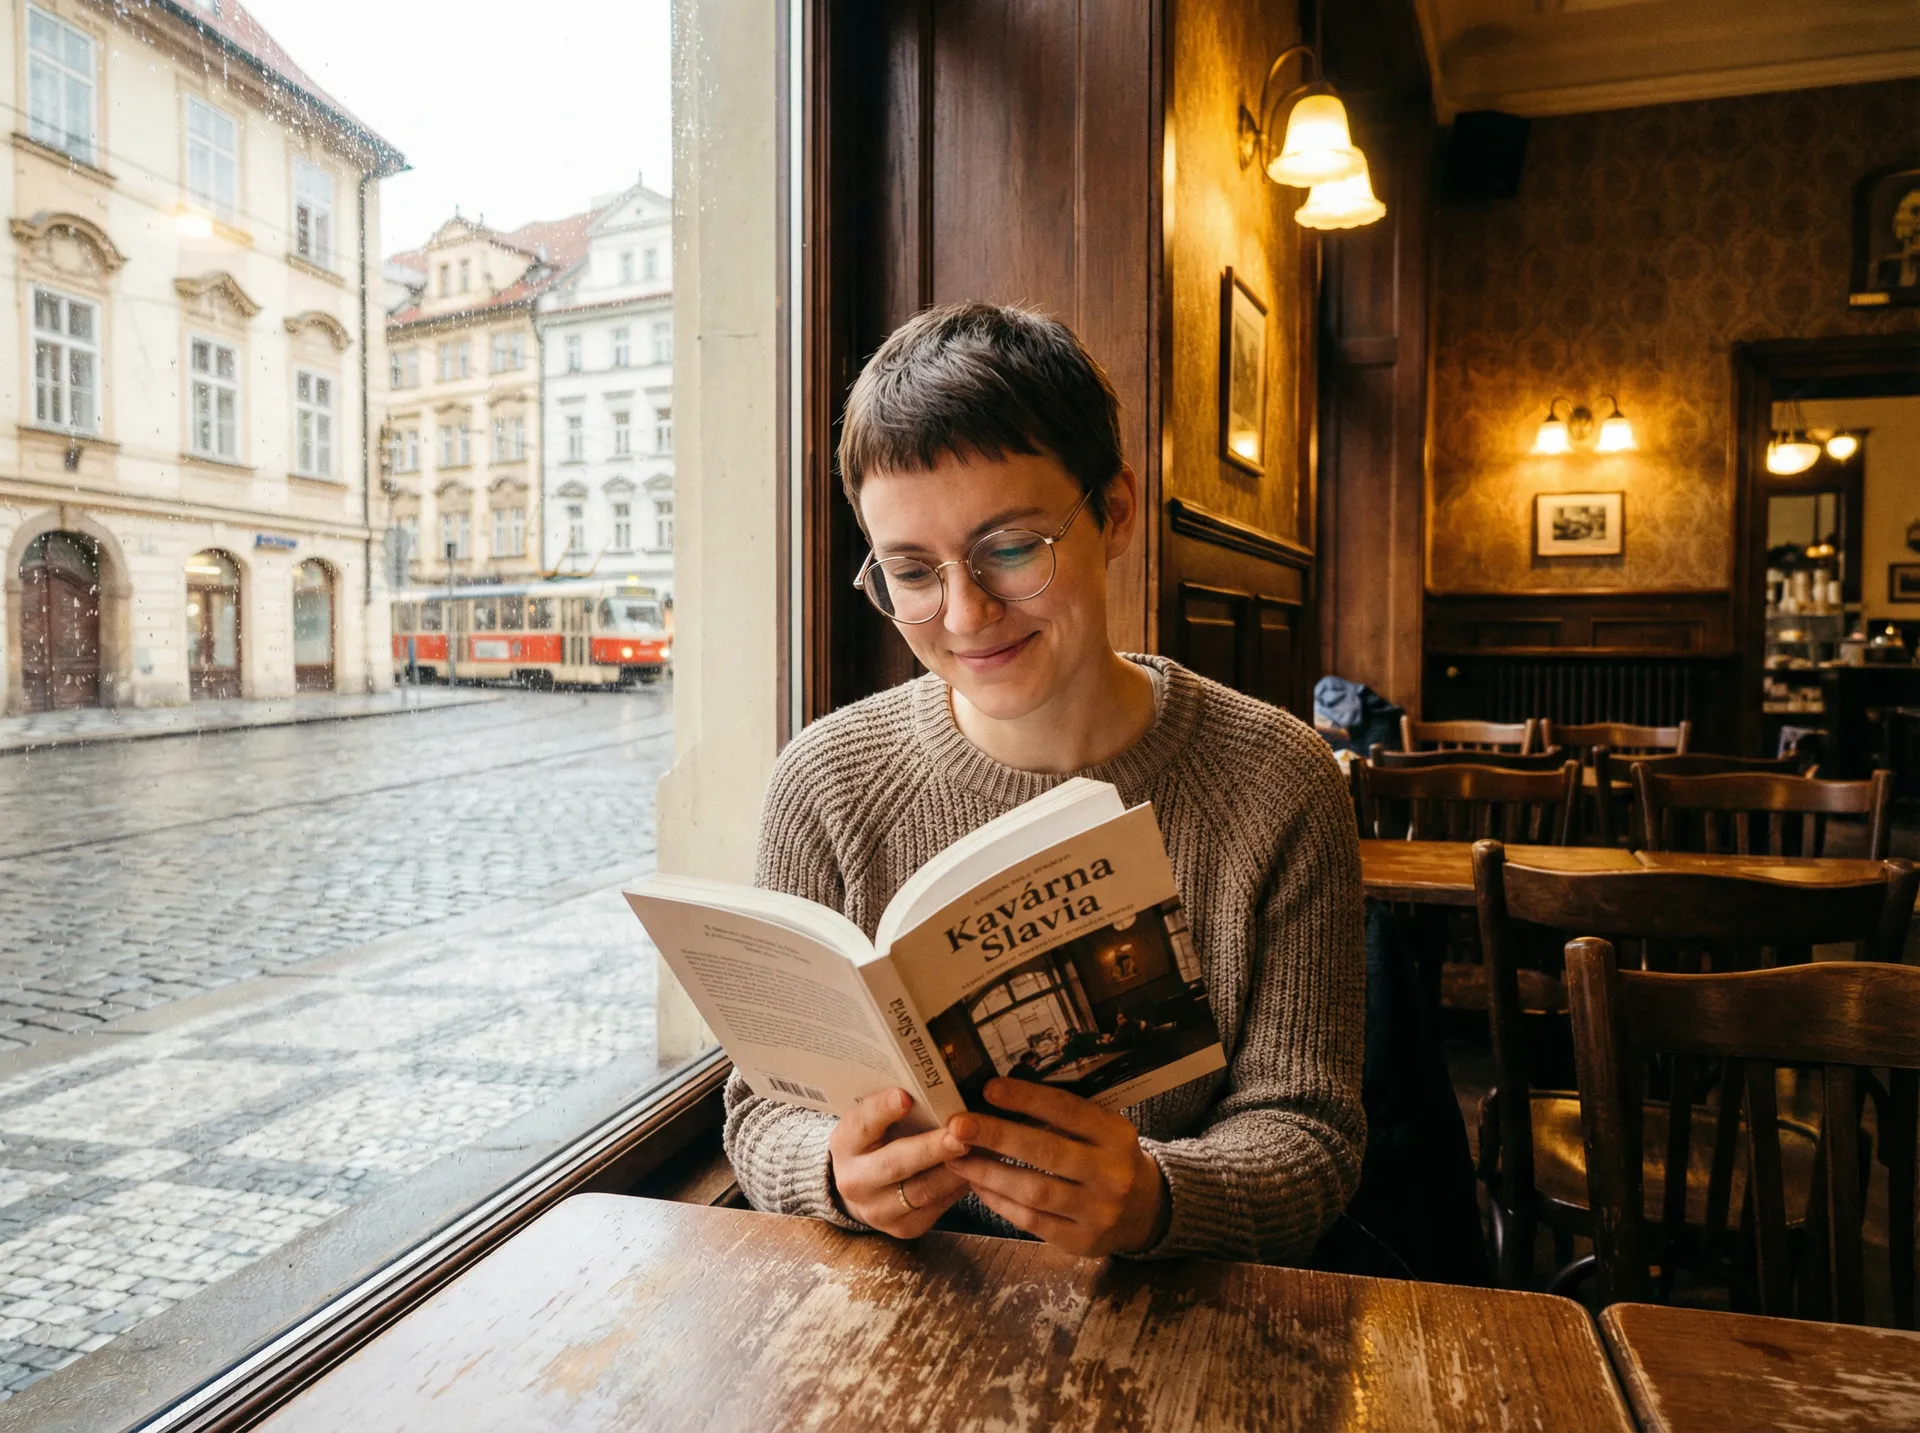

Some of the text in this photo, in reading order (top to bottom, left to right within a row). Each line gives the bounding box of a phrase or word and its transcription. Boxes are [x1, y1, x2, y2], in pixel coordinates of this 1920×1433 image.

[944, 858, 1115, 953] Kavárna
[980, 895, 1102, 962] Slavia
[888, 998, 917, 1037] Slavia
